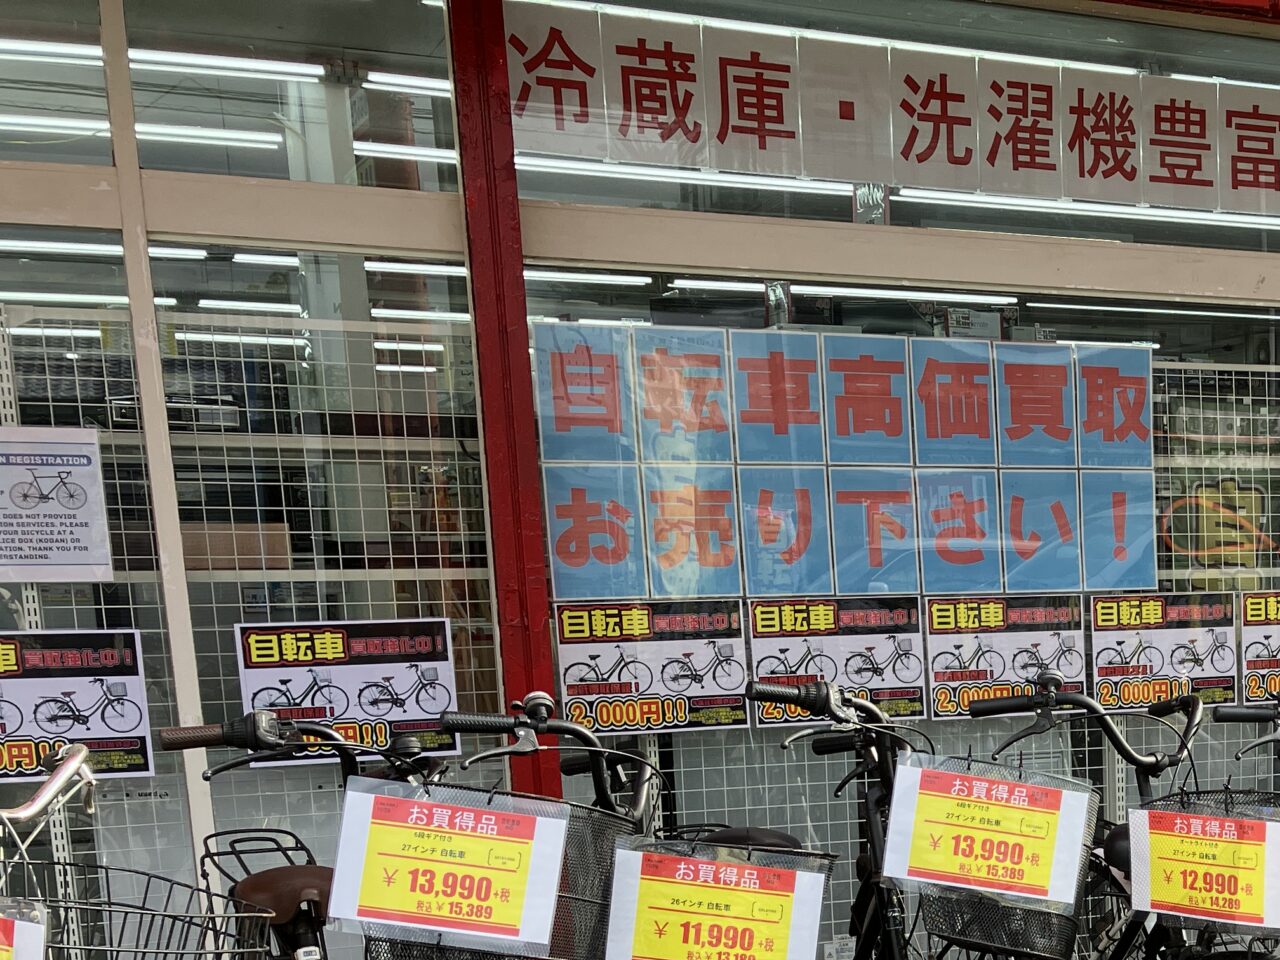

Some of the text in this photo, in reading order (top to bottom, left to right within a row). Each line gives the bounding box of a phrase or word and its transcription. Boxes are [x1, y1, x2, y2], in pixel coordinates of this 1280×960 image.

[550, 341, 1150, 443] 自転車高価買取
[9, 455, 88, 466] REGISTRATION
[554, 485, 1127, 569] お売り下さい！
[561, 608, 650, 638] 自転車
[754, 604, 836, 633] 自転車
[931, 602, 1004, 630] 自転車
[1095, 600, 1163, 626] 自転車
[248, 631, 345, 663] 自転車
[951, 777, 1028, 806] お買得品
[407, 804, 498, 836] お買得品
[1174, 817, 1237, 840] お買得品
[401, 843, 466, 859] 27インチ 自転車
[951, 834, 1024, 866] 13,990
[408, 868, 493, 903] 13,990
[675, 861, 760, 889] お買得品
[1180, 869, 1239, 896] 12,990
[670, 897, 731, 912] 26インチ 自転車
[680, 921, 755, 951] 11,990
